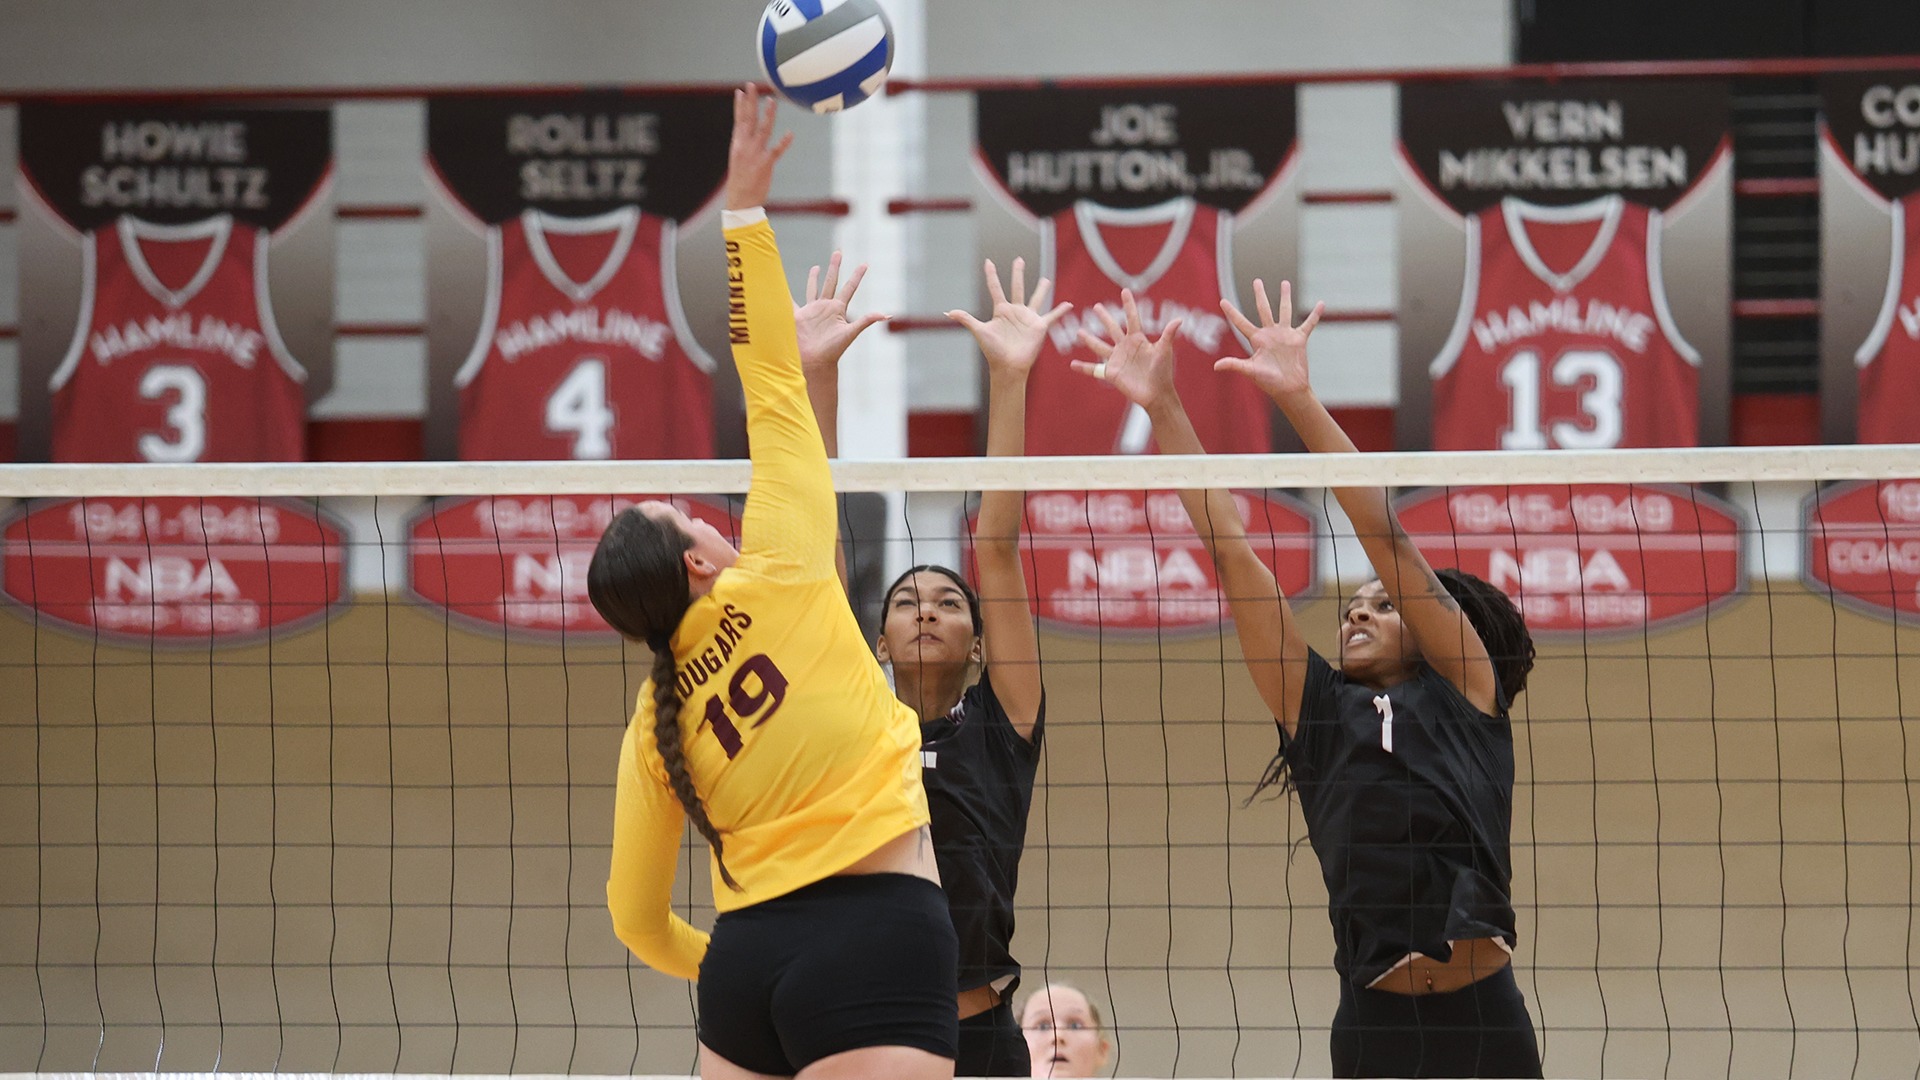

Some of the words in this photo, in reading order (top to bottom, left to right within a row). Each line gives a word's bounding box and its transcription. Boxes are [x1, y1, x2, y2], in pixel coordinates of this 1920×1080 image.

[103, 122, 247, 160] HOWIE
[507, 113, 658, 154] ROLLIE
[1091, 104, 1177, 145] JOE
[1503, 101, 1622, 141] VERN
[82, 167, 268, 207] SCHULTZ
[520, 159, 645, 199] SELTZ
[1439, 147, 1688, 188] MIKKELSEN
[93, 315, 262, 365] HAMLINE
[496, 309, 670, 360] HAMLINE
[1473, 297, 1656, 353] HAMLINE
[139, 365, 206, 462] 3
[546, 359, 614, 460] 4
[1501, 350, 1624, 449] 13
[105, 556, 242, 600] NBA
[513, 553, 592, 599] NB
[1068, 549, 1207, 591] NBA
[1489, 549, 1630, 592] NBA
[675, 604, 752, 699] OUGARS
[696, 653, 788, 761] 19
[1373, 693, 1393, 753] 1
